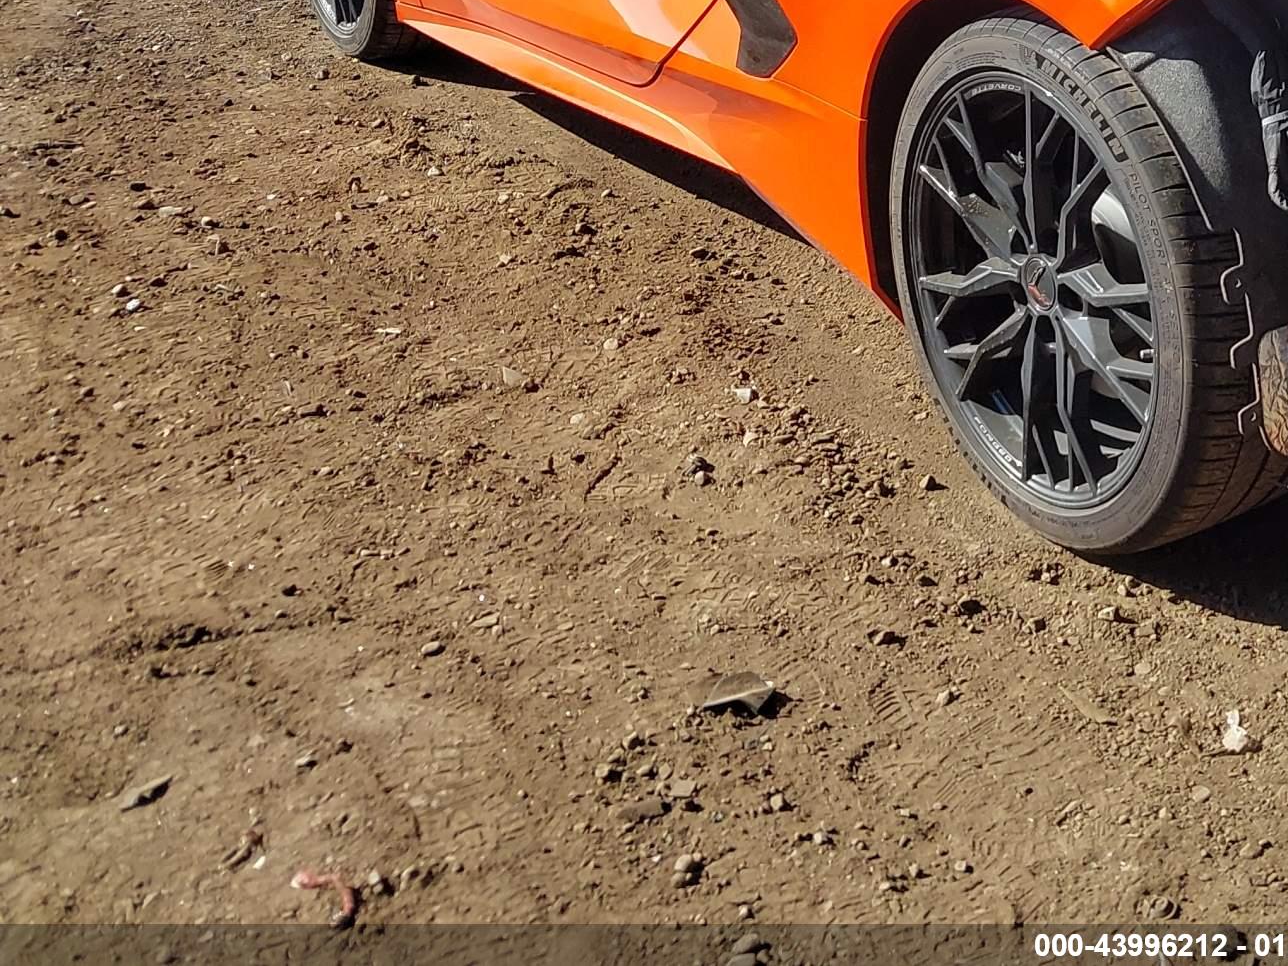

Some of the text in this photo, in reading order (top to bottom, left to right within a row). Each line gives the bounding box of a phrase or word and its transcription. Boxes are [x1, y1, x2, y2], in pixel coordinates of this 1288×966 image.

[971, 83, 1022, 96] CORVETTE
[1040, 60, 1125, 156] MICHELIN
[1129, 173, 1151, 212] PILOT
[1149, 217, 1168, 269] SPORT
